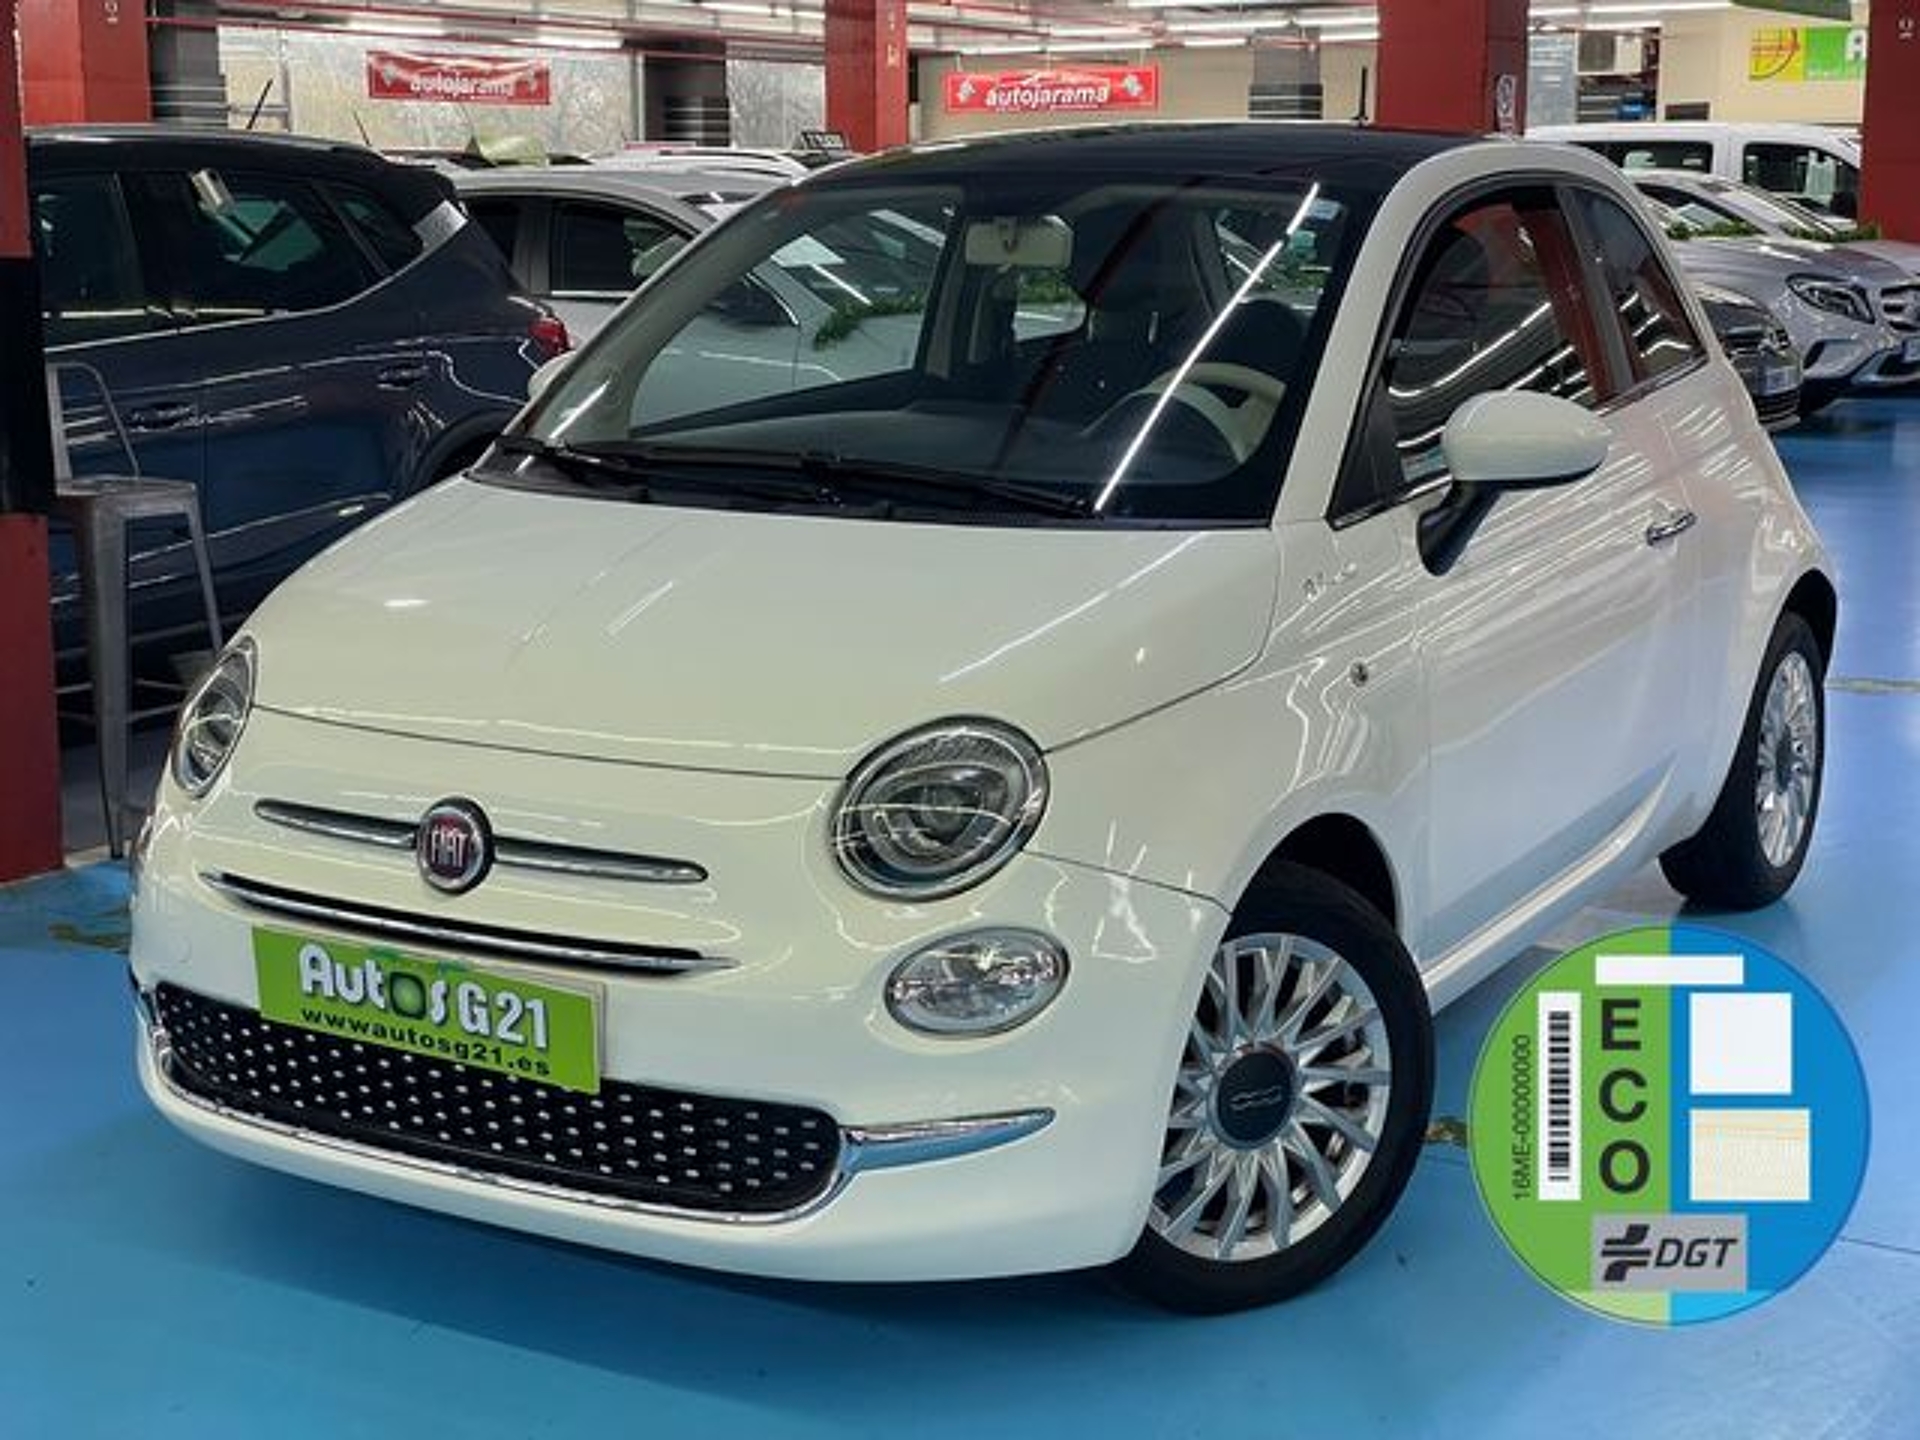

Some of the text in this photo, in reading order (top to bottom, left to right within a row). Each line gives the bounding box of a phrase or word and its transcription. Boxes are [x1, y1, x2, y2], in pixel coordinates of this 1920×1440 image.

[985, 84, 1111, 109] autojarama
[431, 824, 468, 868] FIAT
[457, 982, 549, 1049] G21
